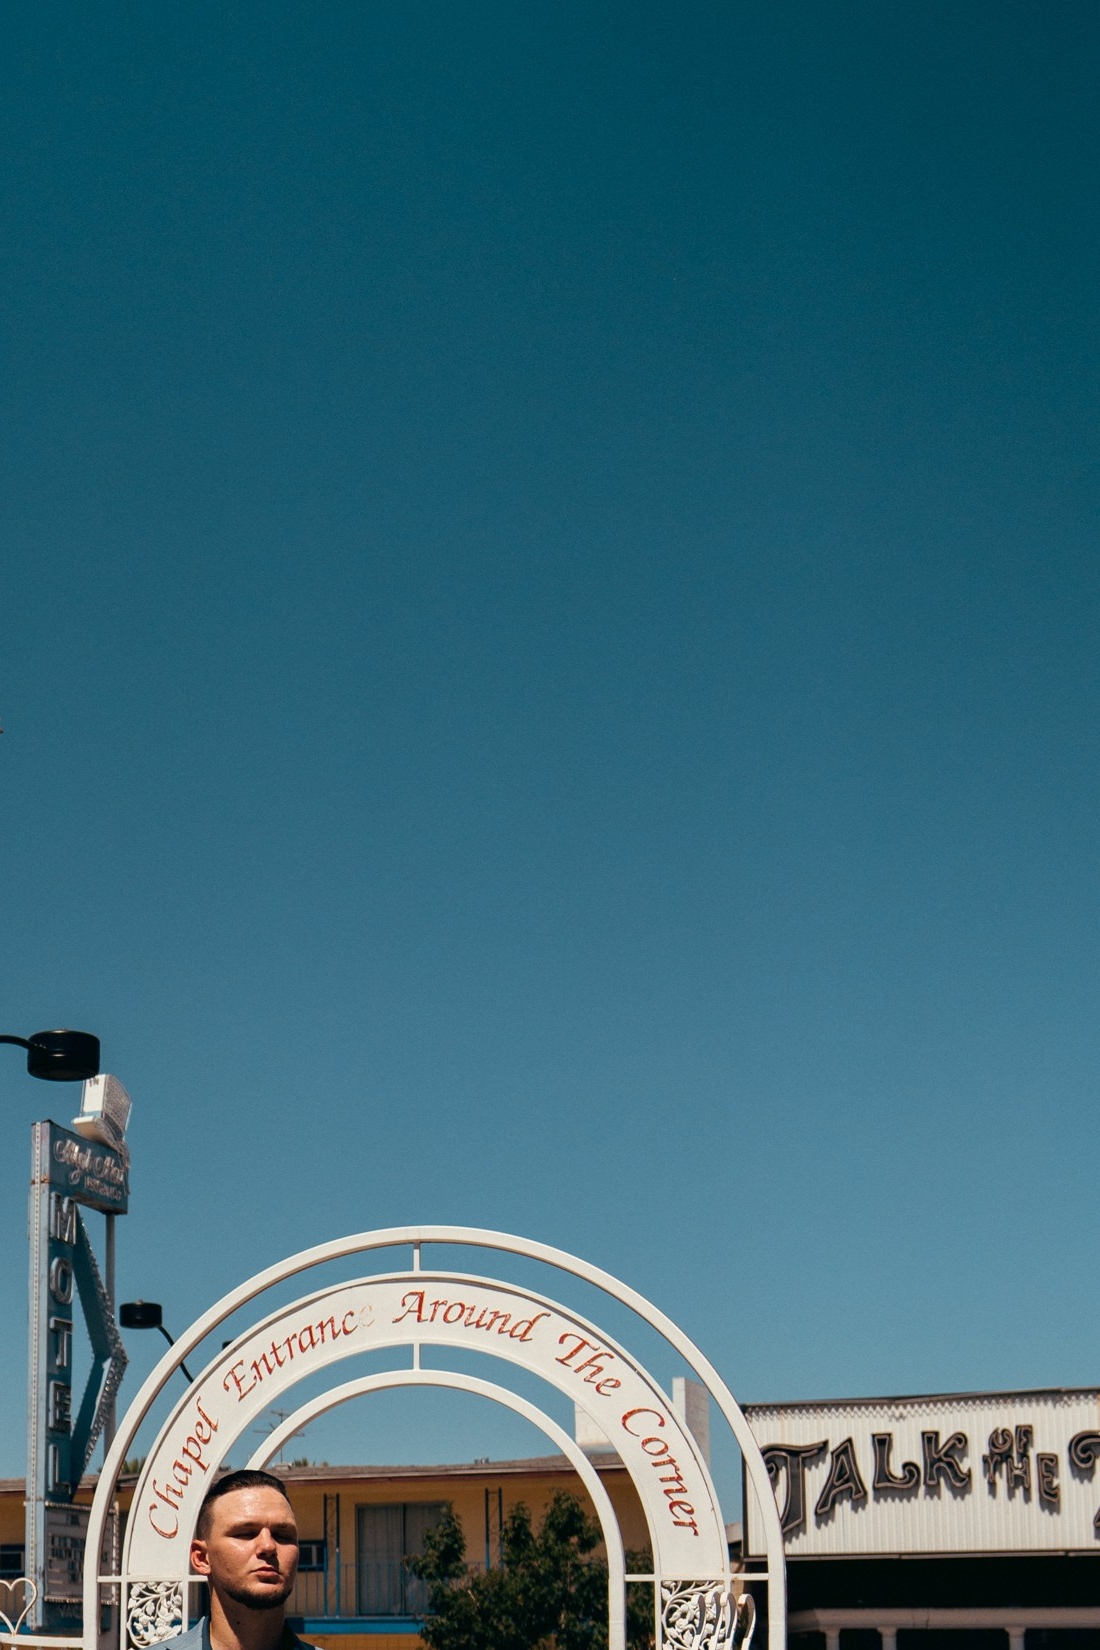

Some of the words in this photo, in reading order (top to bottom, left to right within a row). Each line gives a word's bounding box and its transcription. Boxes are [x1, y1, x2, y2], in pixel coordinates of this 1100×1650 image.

[148, 1395, 219, 1540] Chapel
[392, 1290, 550, 1342] Around
[554, 1331, 622, 1397] The
[620, 1406, 700, 1537] Corner
[988, 1423, 1033, 1454] OF
[760, 1430, 971, 1534] TALK
[981, 1452, 1060, 1503] THE
